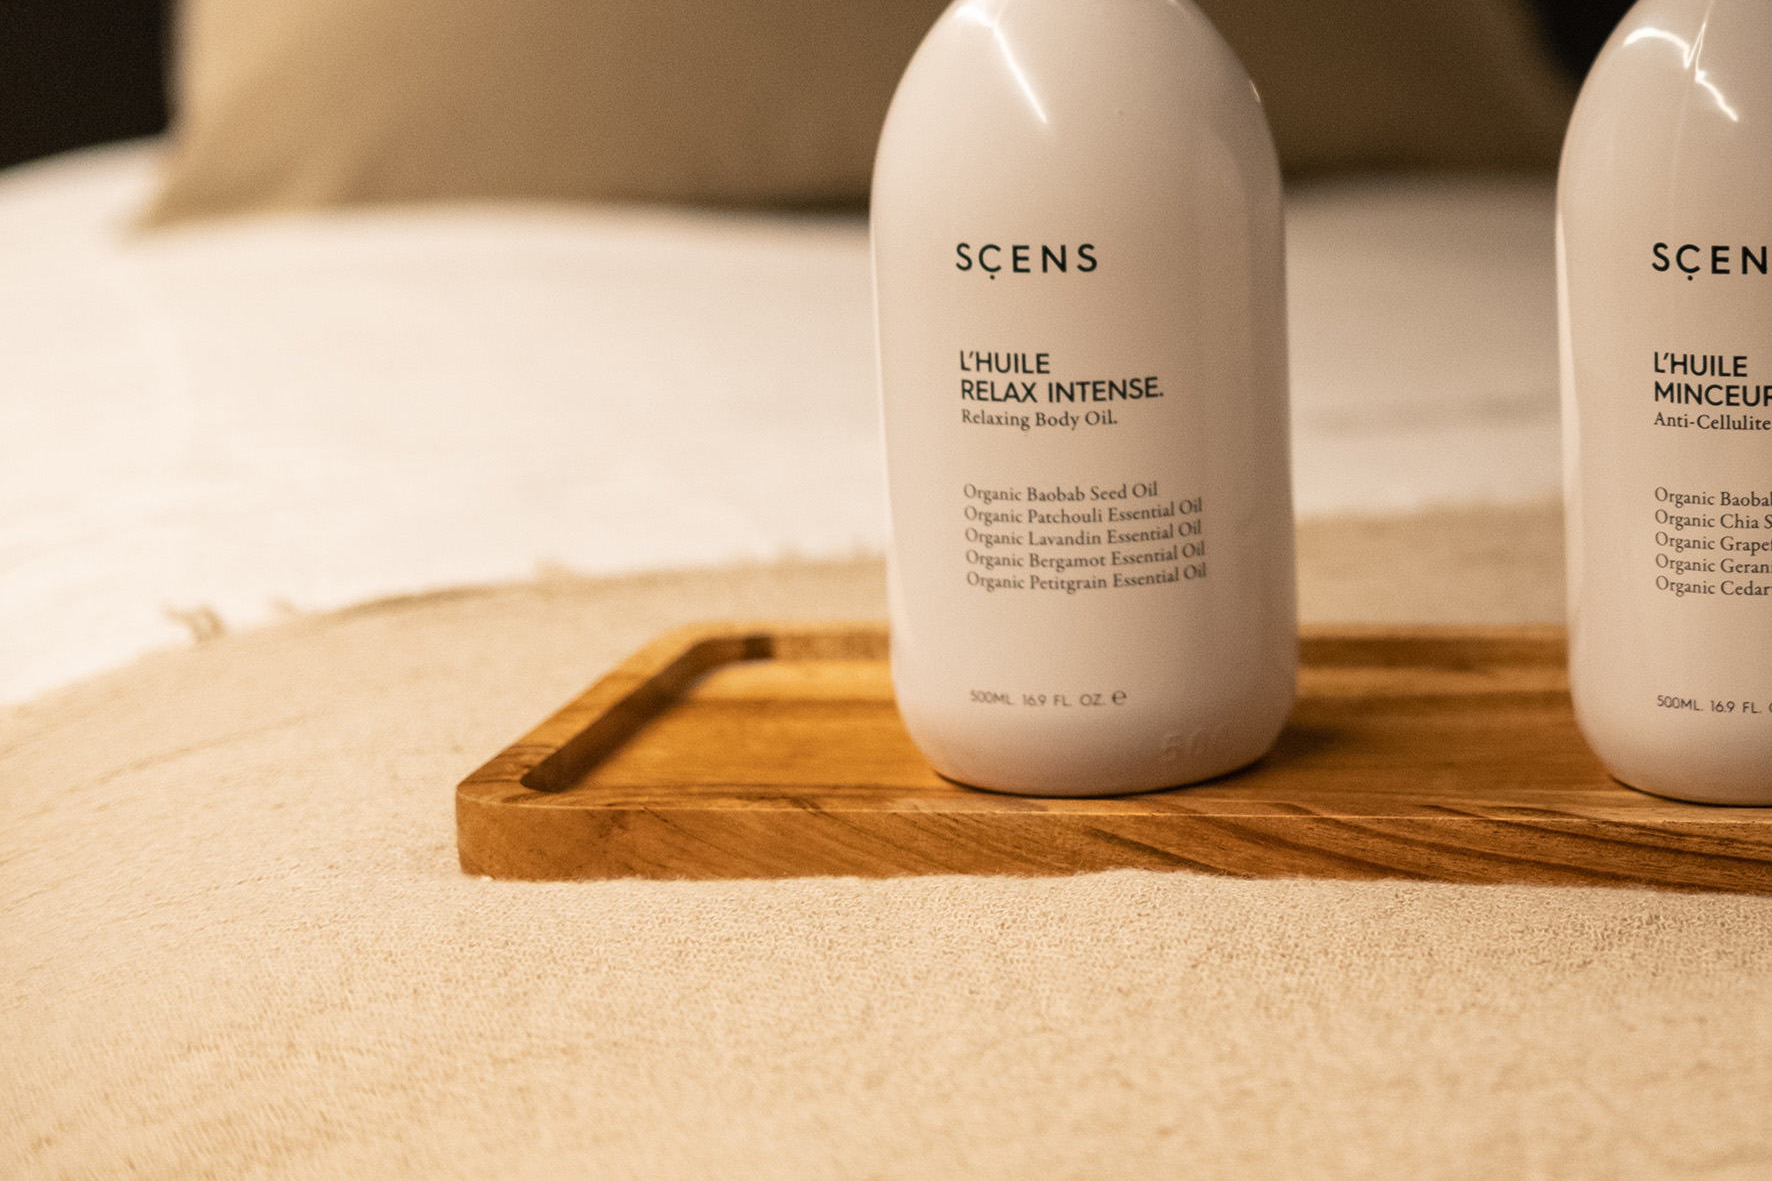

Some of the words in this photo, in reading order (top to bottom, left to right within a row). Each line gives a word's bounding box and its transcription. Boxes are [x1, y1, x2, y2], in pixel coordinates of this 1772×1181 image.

[959, 349, 1051, 375] L'HUILE
[1653, 351, 1748, 378] L'HUILE
[960, 379, 1038, 404] RELAX
[1047, 375, 1164, 404] INTENSE.
[961, 408, 1031, 431] Relaxing
[1034, 411, 1080, 431] Body
[1084, 409, 1118, 426] Oil.
[1653, 411, 1772, 431] Anti-Cellulite
[962, 483, 1023, 505] Organic
[1026, 485, 1086, 502] Baobab
[1089, 483, 1128, 501] Seed
[1131, 480, 1159, 498] Oil
[1654, 486, 1715, 509] Organic
[963, 505, 1024, 527] Organic
[1027, 507, 1103, 525] Patchouli
[1107, 500, 1175, 522] Essential
[1178, 496, 1204, 515] Oil
[1654, 508, 1715, 531] Organic
[1719, 513, 1760, 530] Chia
[964, 527, 1024, 549] Organic
[1027, 529, 1103, 547] Lavandin
[1106, 522, 1175, 545] Essential
[1177, 519, 1202, 537] Oil
[1654, 530, 1716, 553] Organic
[965, 549, 1025, 571] Organic
[1028, 552, 1107, 573] Bergamot
[1110, 544, 1179, 566] Essential
[1181, 540, 1206, 558] Oil
[1655, 552, 1716, 576] Organic
[965, 570, 1025, 593] Organic
[1029, 574, 1108, 595] Petitgrain
[1112, 565, 1180, 588] Essential
[1183, 562, 1208, 580] Oil
[1655, 574, 1716, 598] Organic
